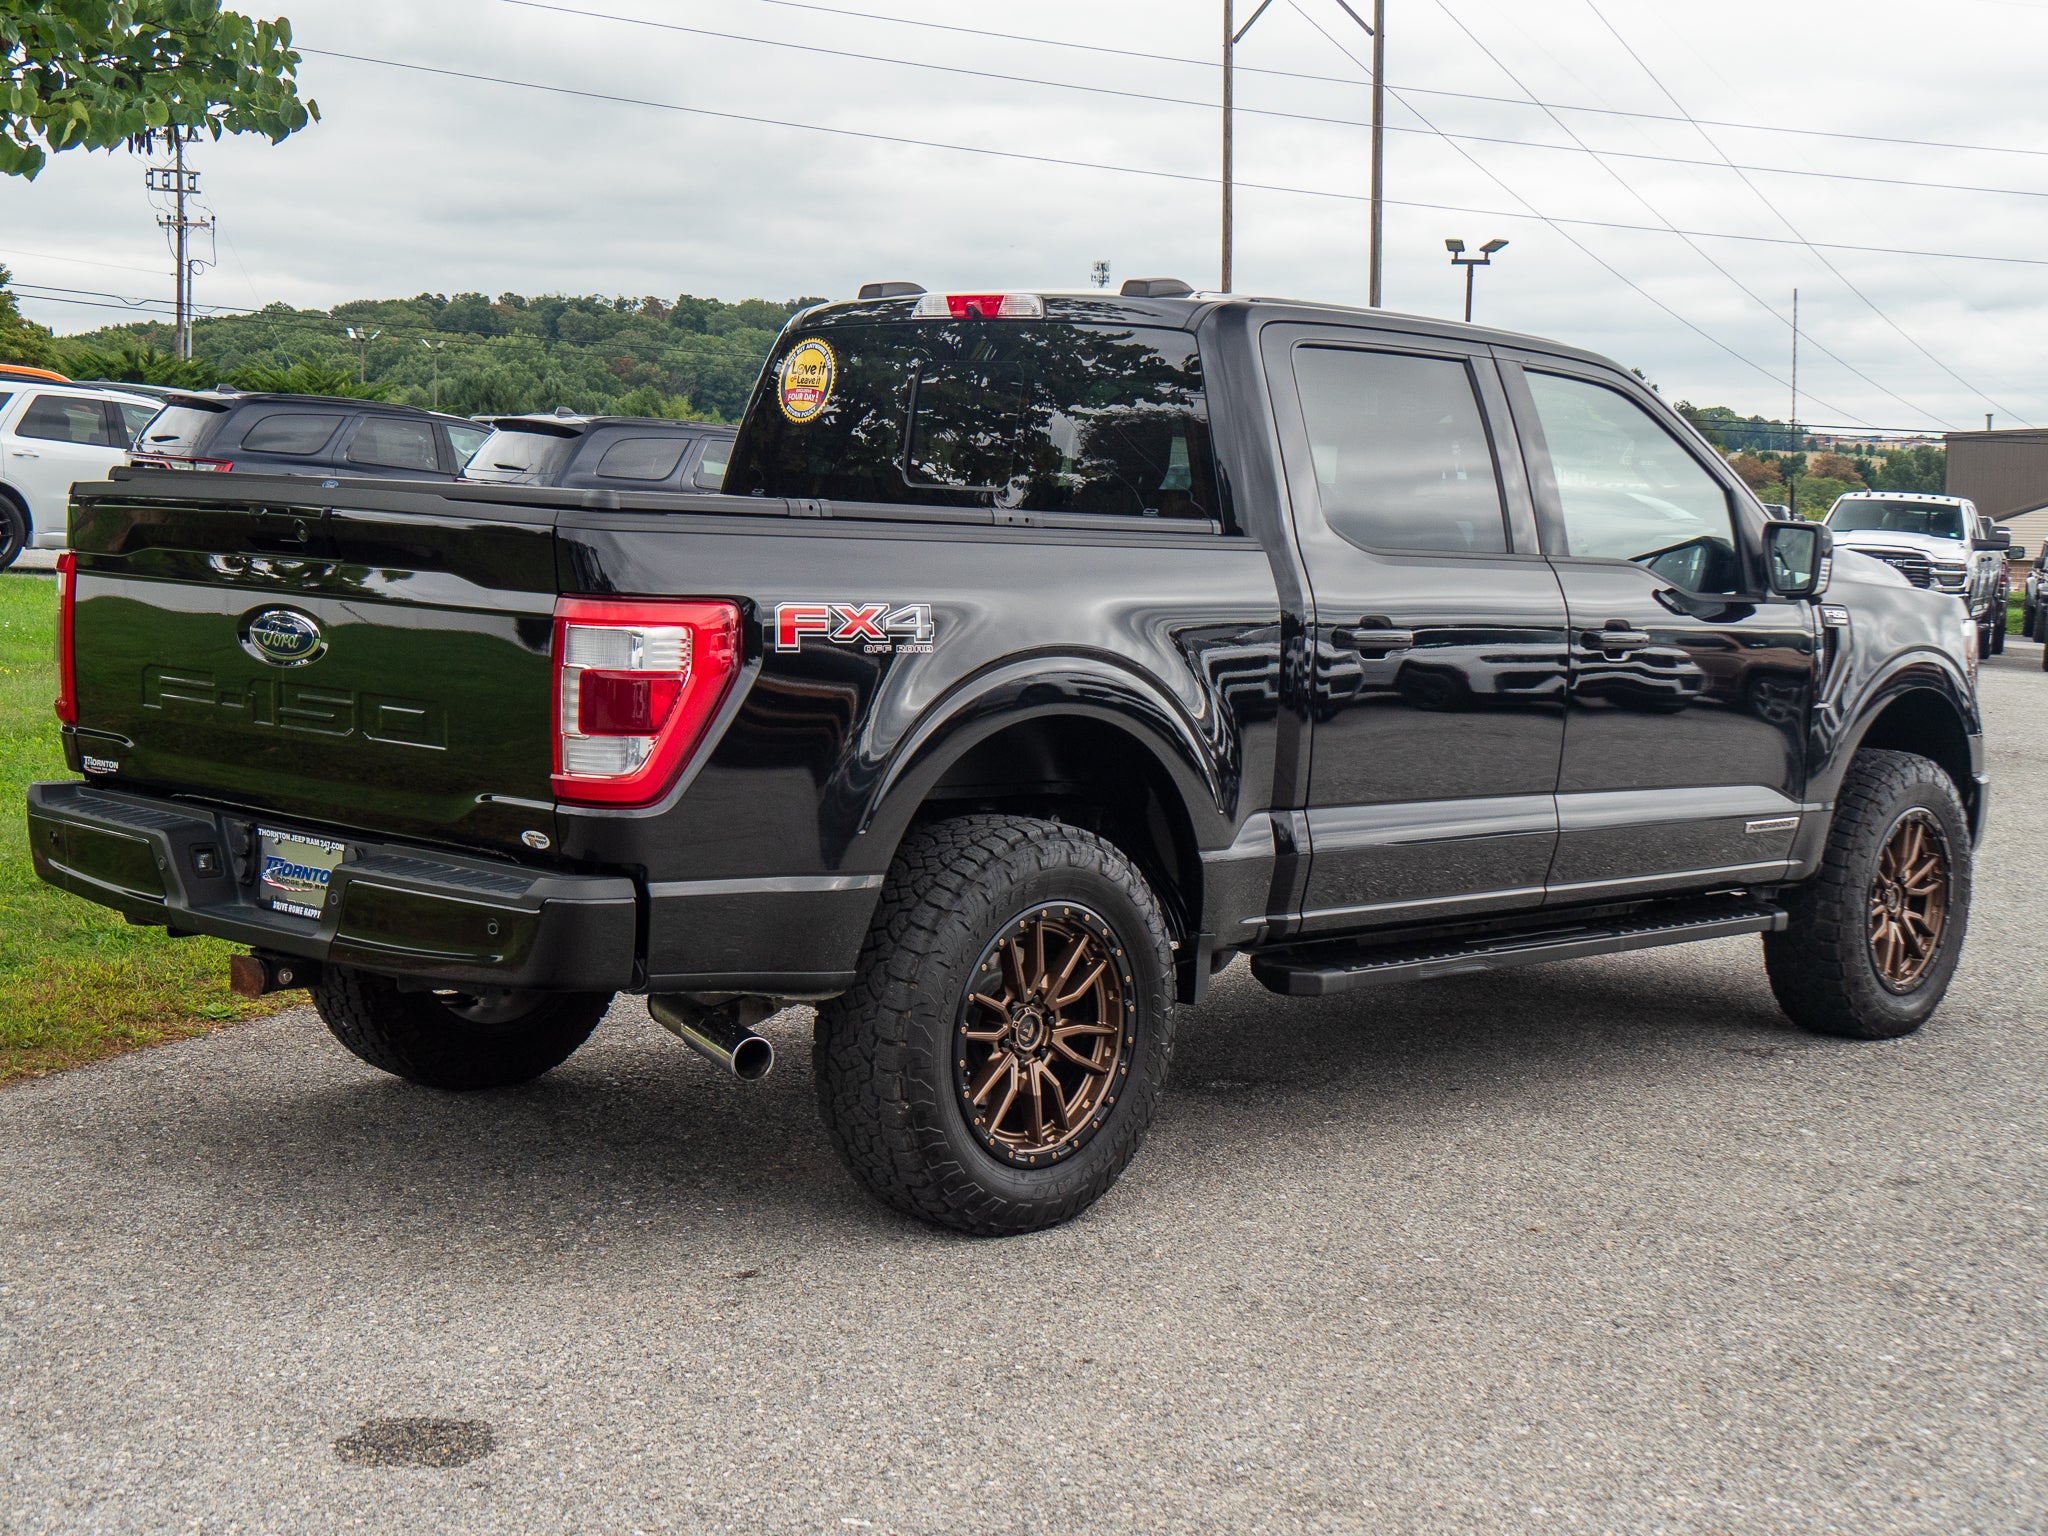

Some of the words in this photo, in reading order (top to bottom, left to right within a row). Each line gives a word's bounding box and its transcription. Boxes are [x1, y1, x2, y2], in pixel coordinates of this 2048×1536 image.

[792, 360, 817, 376] Love
[818, 361, 827, 376] it
[797, 376, 815, 385] Leave
[815, 376, 821, 385] it
[787, 392, 803, 401] FOUR
[262, 619, 303, 649] Ford
[775, 602, 935, 653] FX4
[864, 644, 892, 654] OFF
[896, 644, 934, 654] ROAD
[142, 664, 447, 751] F-150
[83, 755, 119, 769] THORNTON
[258, 828, 290, 841] THORNTON
[291, 834, 306, 843] JEEP
[306, 837, 320, 847] RAM
[264, 855, 332, 884] THORNTO
[273, 900, 288, 911] DRIVE
[289, 904, 304, 915] HOME
[304, 908, 321, 918] HAPPY
